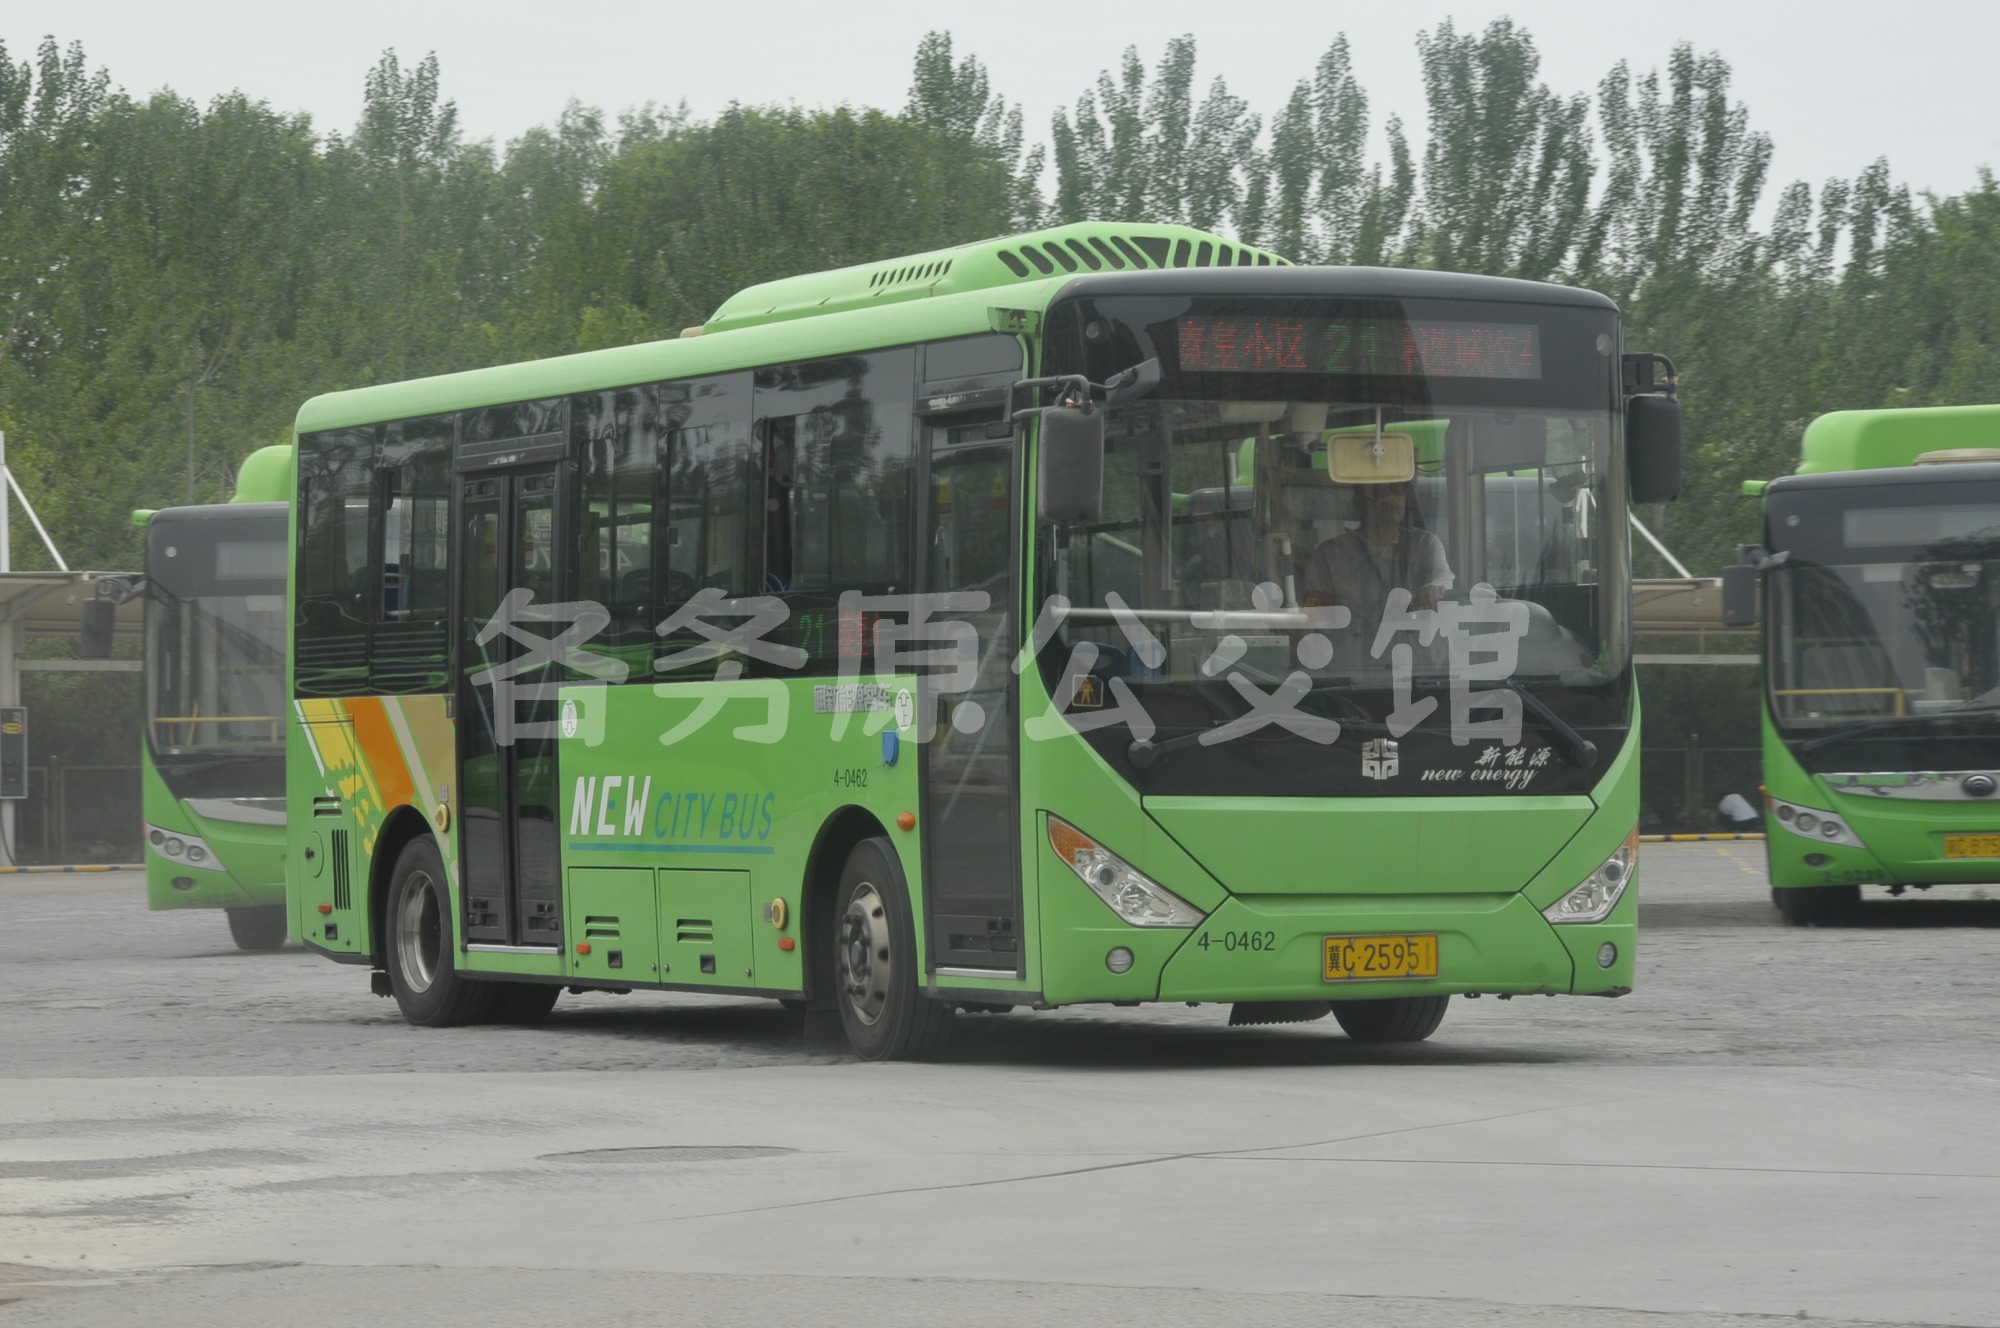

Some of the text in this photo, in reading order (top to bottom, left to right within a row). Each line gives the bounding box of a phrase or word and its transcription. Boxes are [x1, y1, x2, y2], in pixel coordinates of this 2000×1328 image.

[1325, 325, 1377, 372] 21
[799, 613, 825, 659] 21
[1474, 745, 1552, 768] 新能源
[834, 768, 868, 788] 4-0462
[1420, 768, 1539, 790] new energy
[569, 776, 776, 841] NEW CITY BUS
[1197, 930, 1276, 951] 4-0462
